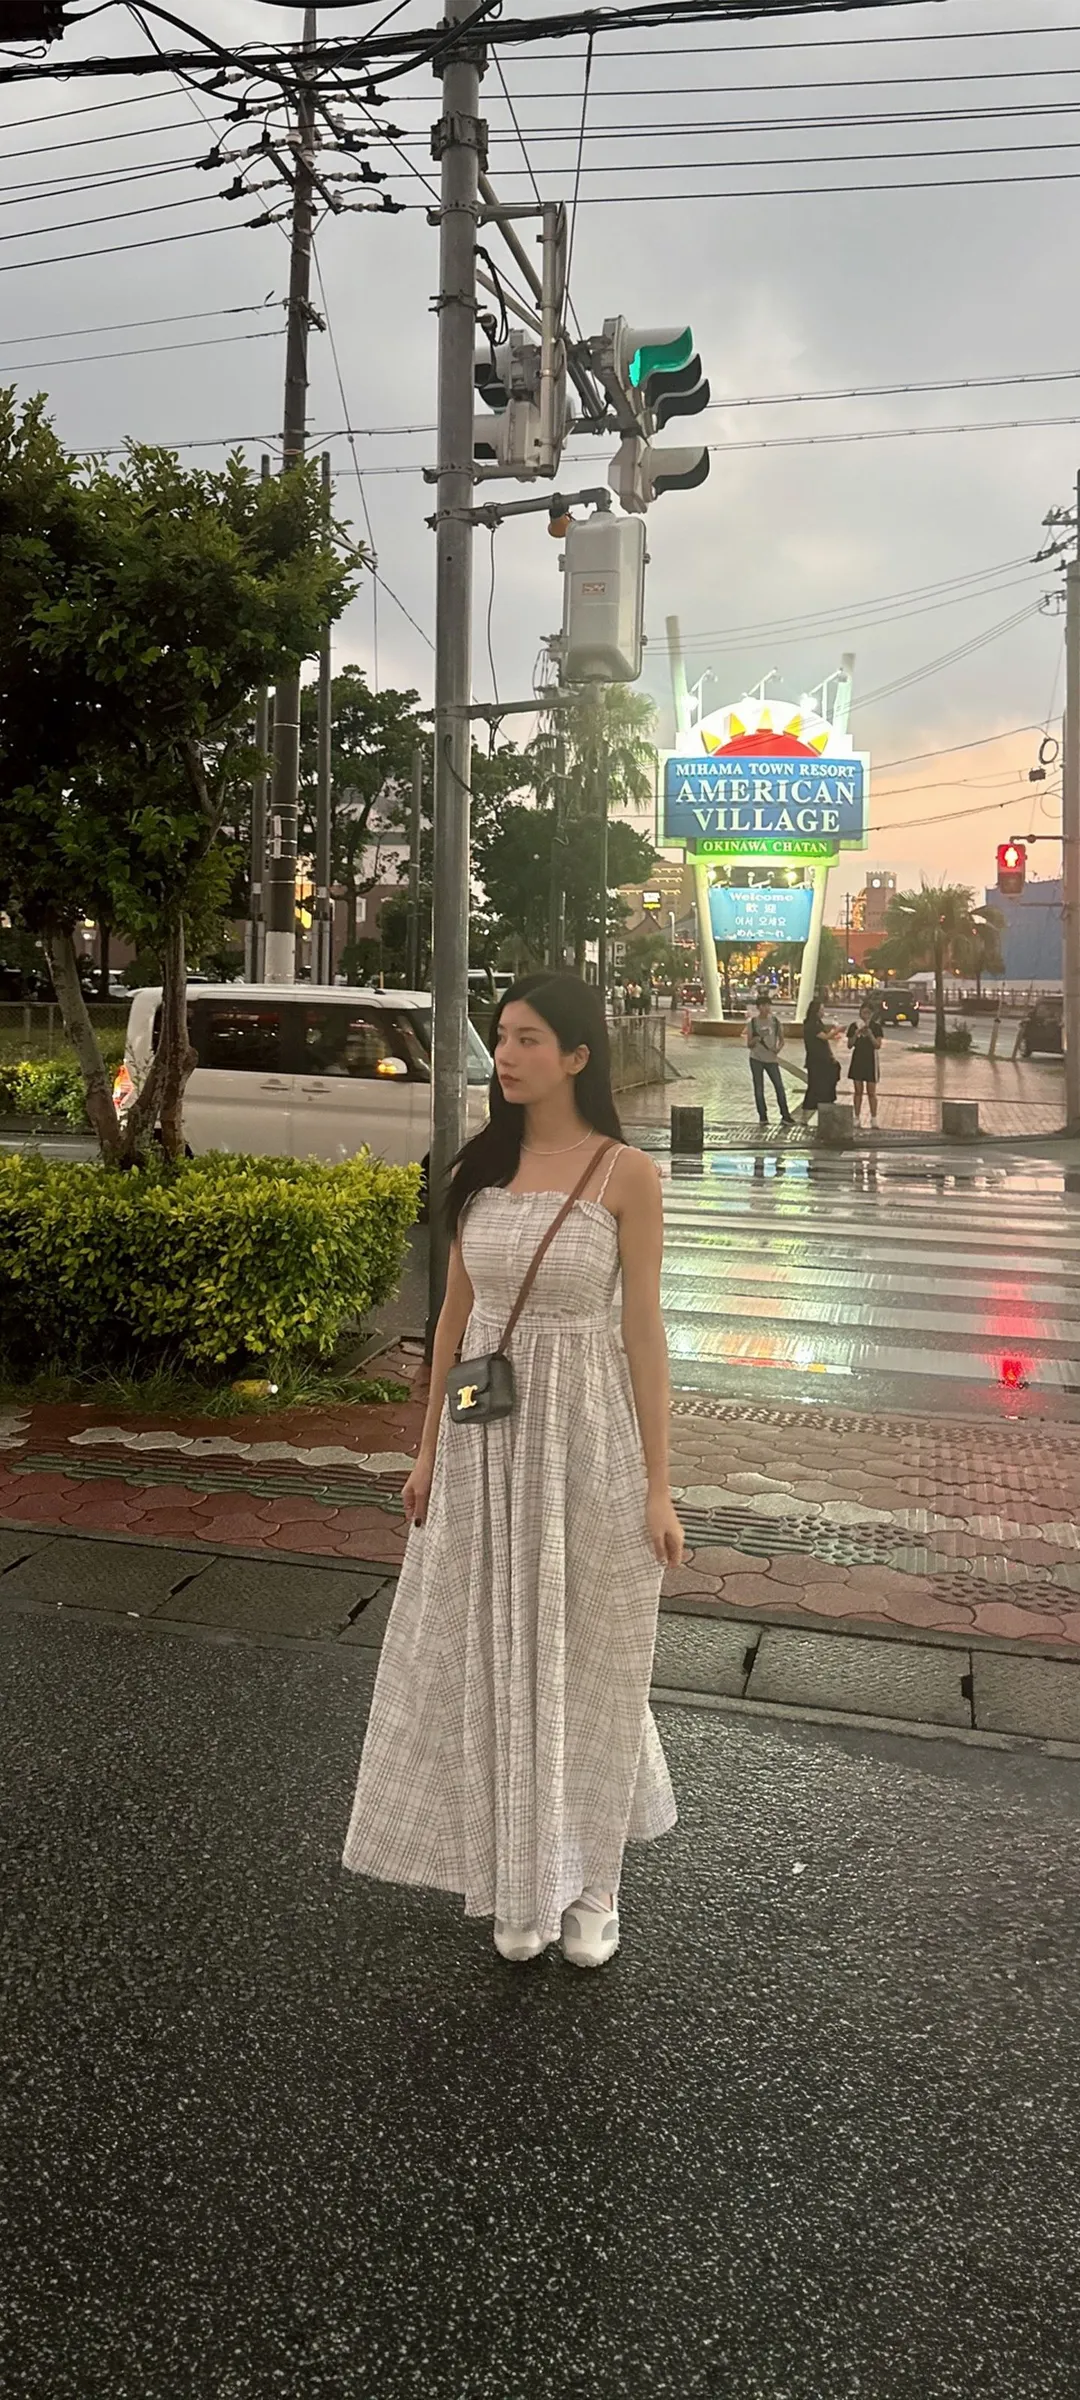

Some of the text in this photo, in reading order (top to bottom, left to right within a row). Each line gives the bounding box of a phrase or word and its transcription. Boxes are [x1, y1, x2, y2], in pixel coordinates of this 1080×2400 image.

[676, 763, 856, 778] MIHAMA TOWN RESORT
[676, 780, 855, 805] AMERICAN
[693, 808, 840, 832] VILLAGE
[703, 840, 828, 853] OKINAWA CHATAN
[729, 892, 794, 902] Welcome
[735, 916, 786, 927] 어서 오세요
